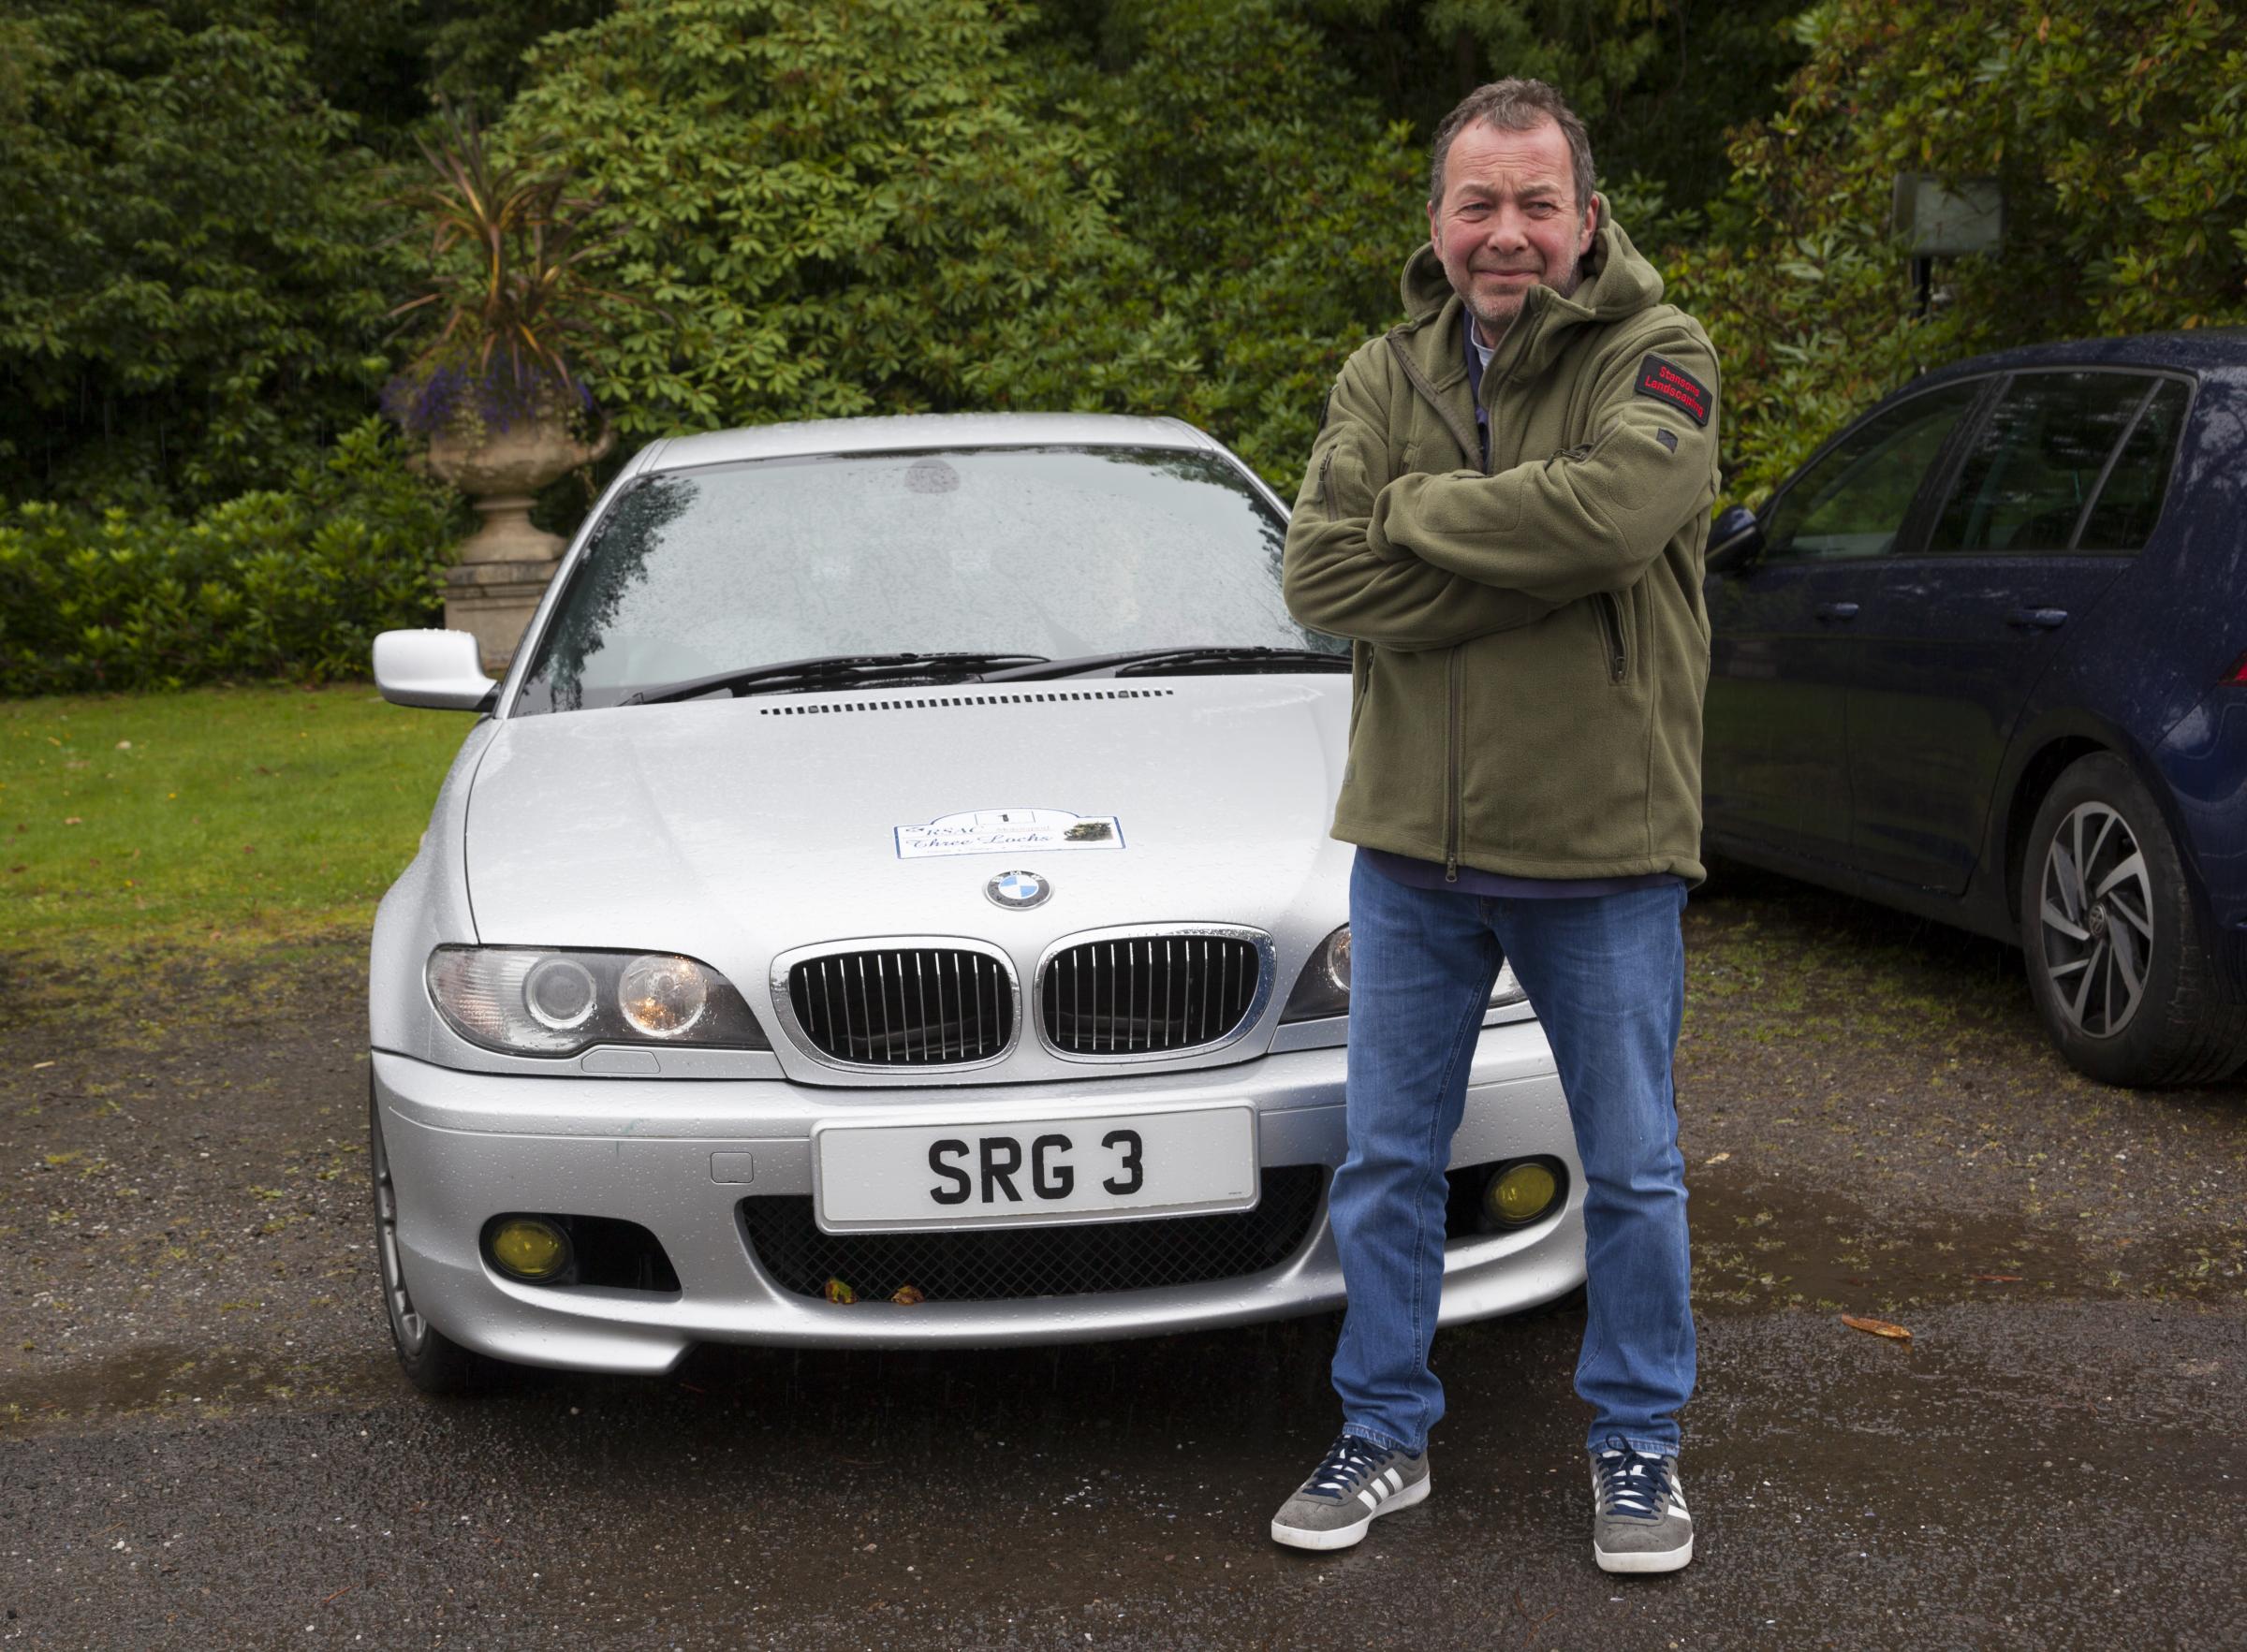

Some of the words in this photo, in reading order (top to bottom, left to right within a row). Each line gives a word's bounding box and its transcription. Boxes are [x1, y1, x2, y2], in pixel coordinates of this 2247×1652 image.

[1644, 375, 1704, 418] Landscaping
[1659, 365, 1700, 397] Stansons
[905, 838, 974, 849] Three
[977, 833, 1053, 844] Lochs
[928, 1133, 1074, 1205] SRG
[1101, 1129, 1144, 1196] 3
